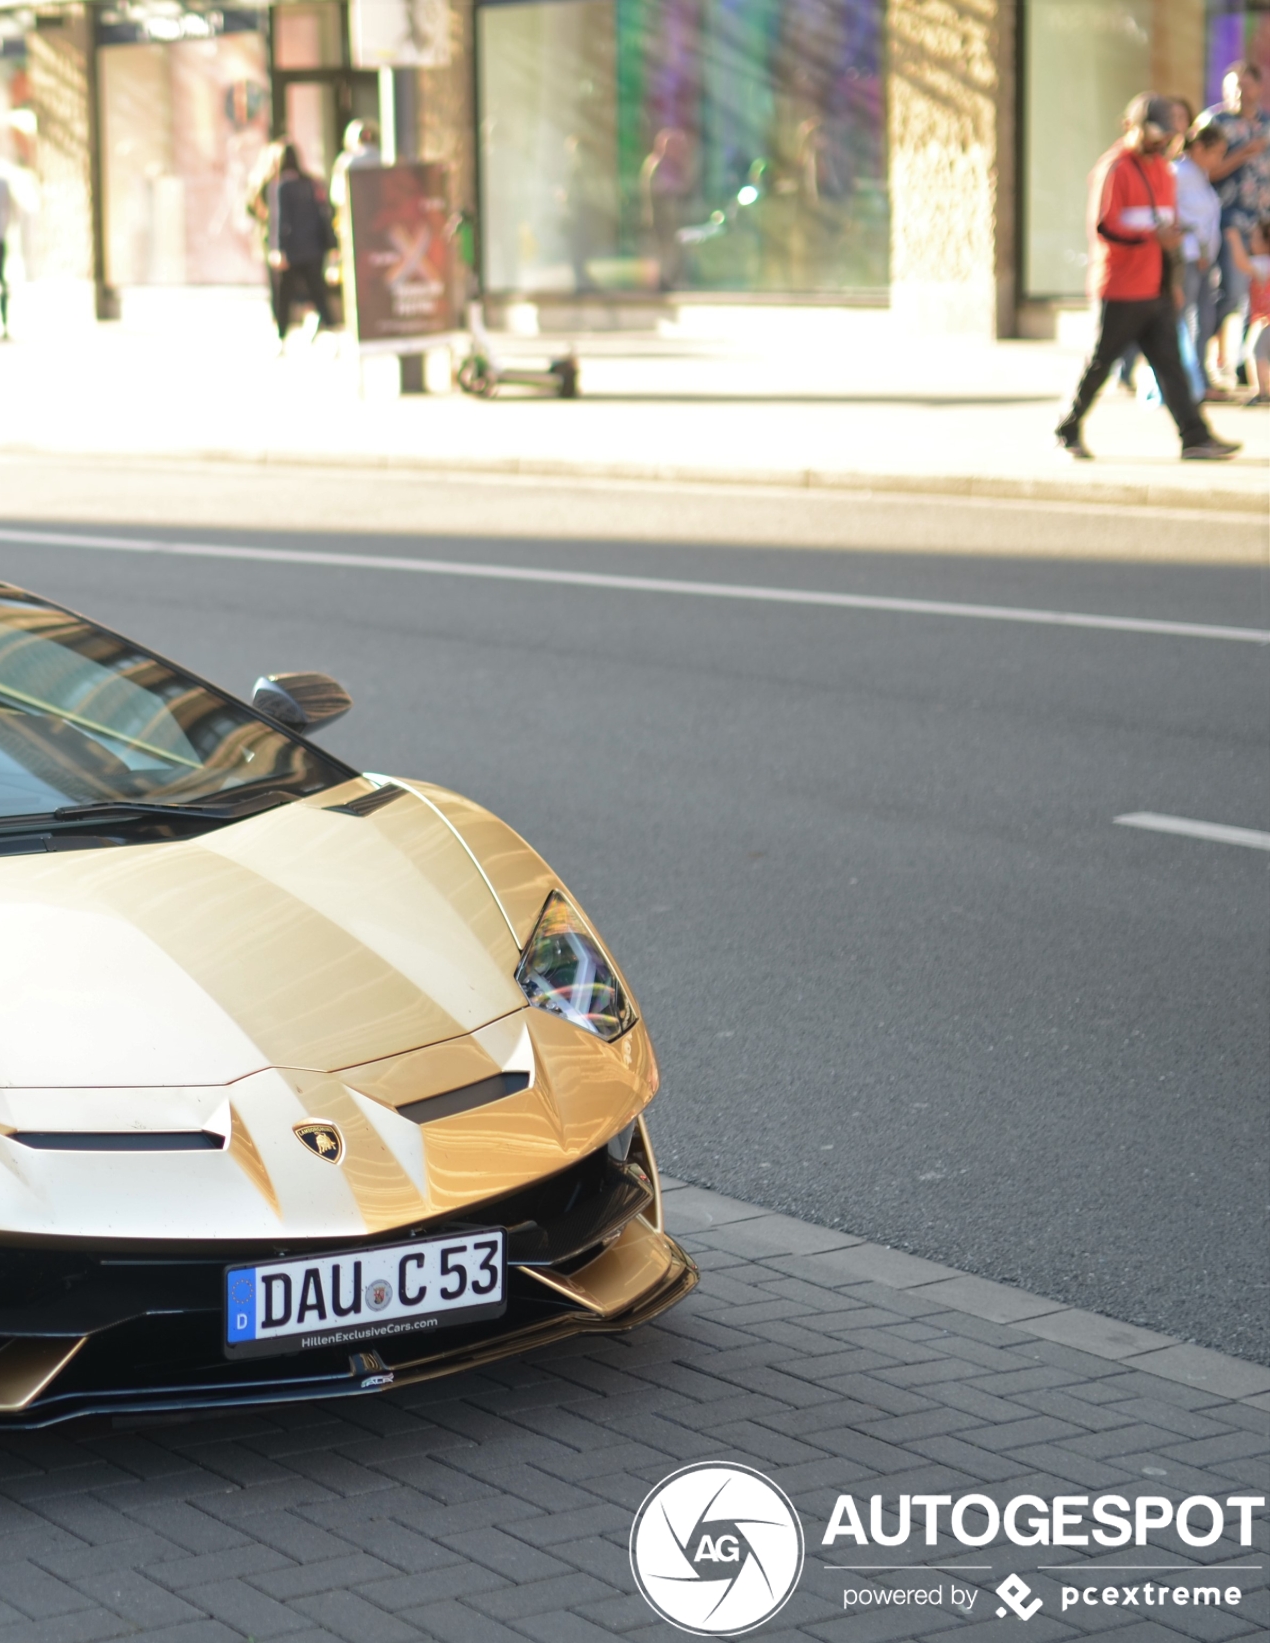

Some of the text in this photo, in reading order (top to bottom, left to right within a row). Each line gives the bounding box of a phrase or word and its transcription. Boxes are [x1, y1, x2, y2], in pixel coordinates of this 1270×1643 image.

[261, 1240, 499, 1329] DAU C 53
[236, 1313, 248, 1330] D
[301, 1317, 438, 1348] HillenExclusiveCars.com
